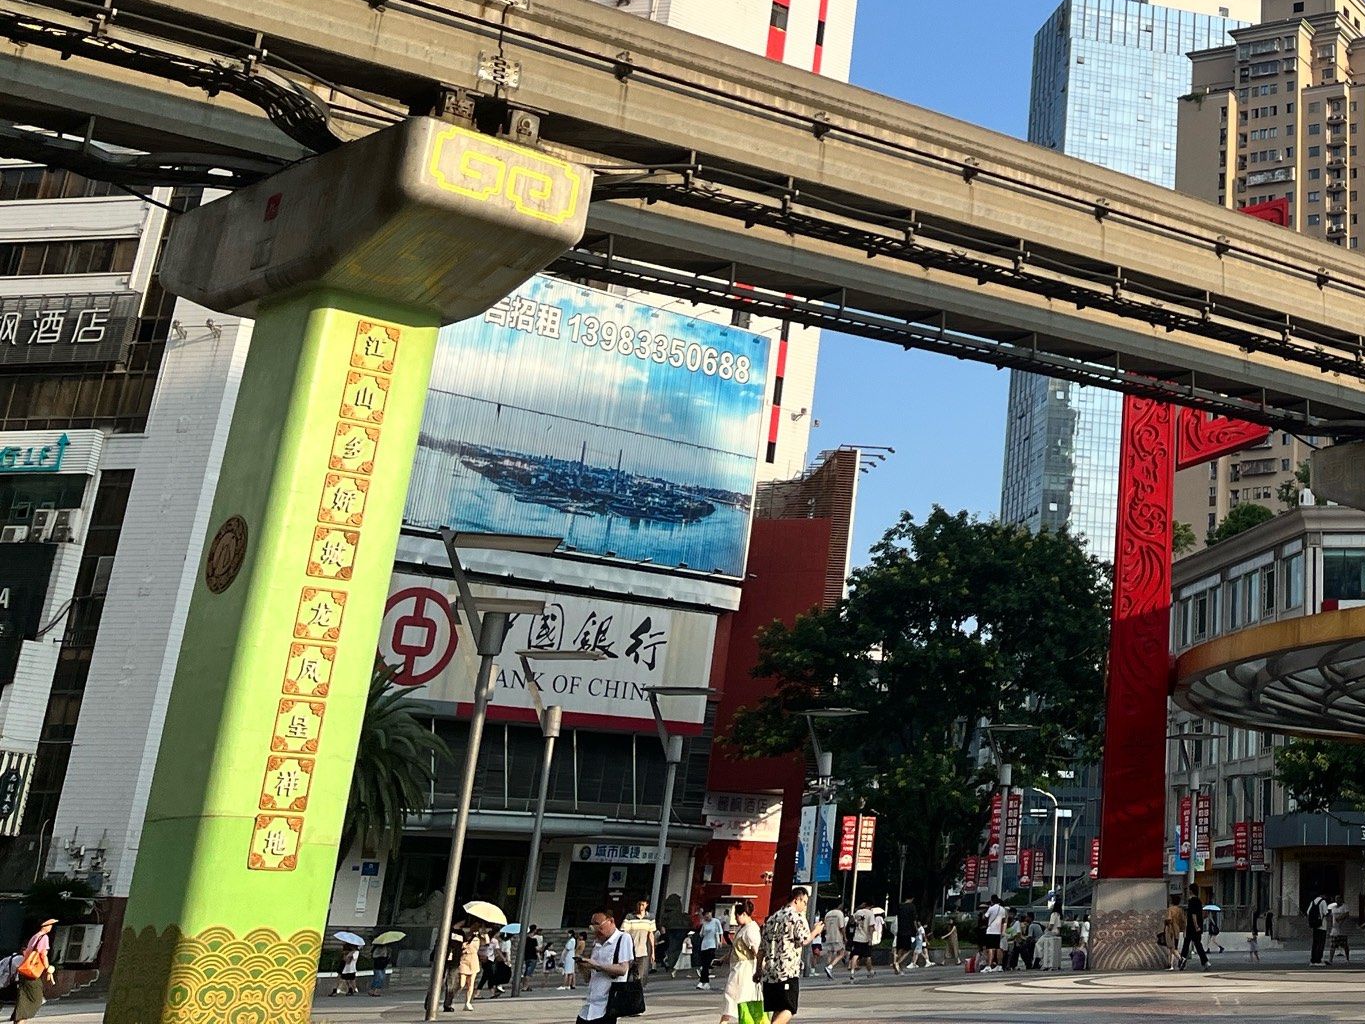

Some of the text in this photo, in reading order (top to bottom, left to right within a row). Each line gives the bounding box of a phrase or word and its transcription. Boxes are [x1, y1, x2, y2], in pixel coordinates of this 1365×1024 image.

[568, 312, 751, 385] 13983350688
[496, 668, 546, 693] ANK
[552, 674, 582, 695] OF
